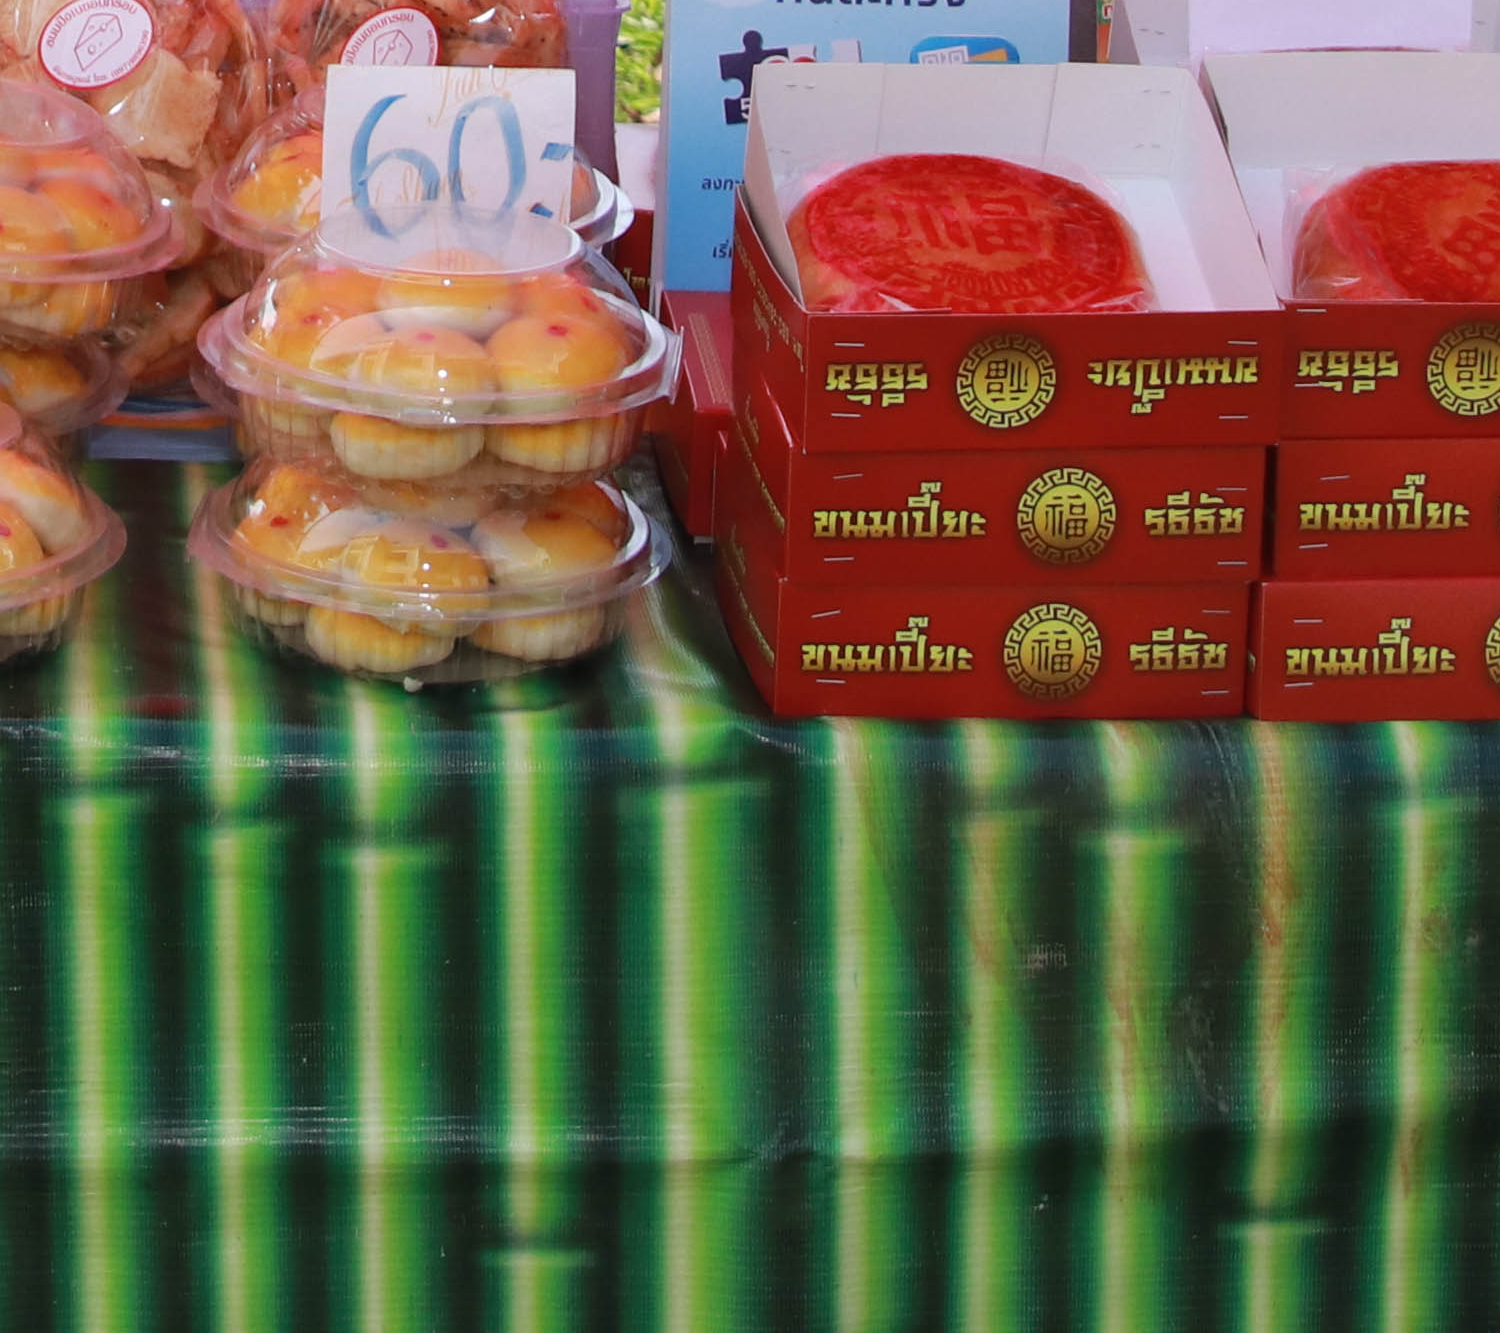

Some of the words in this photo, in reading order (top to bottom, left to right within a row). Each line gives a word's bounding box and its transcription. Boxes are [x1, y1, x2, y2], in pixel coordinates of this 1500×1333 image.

[985, 358, 1029, 404] 福
[1454, 347, 1500, 392] 福
[1043, 494, 1088, 541] 福
[1029, 629, 1074, 676] 福
